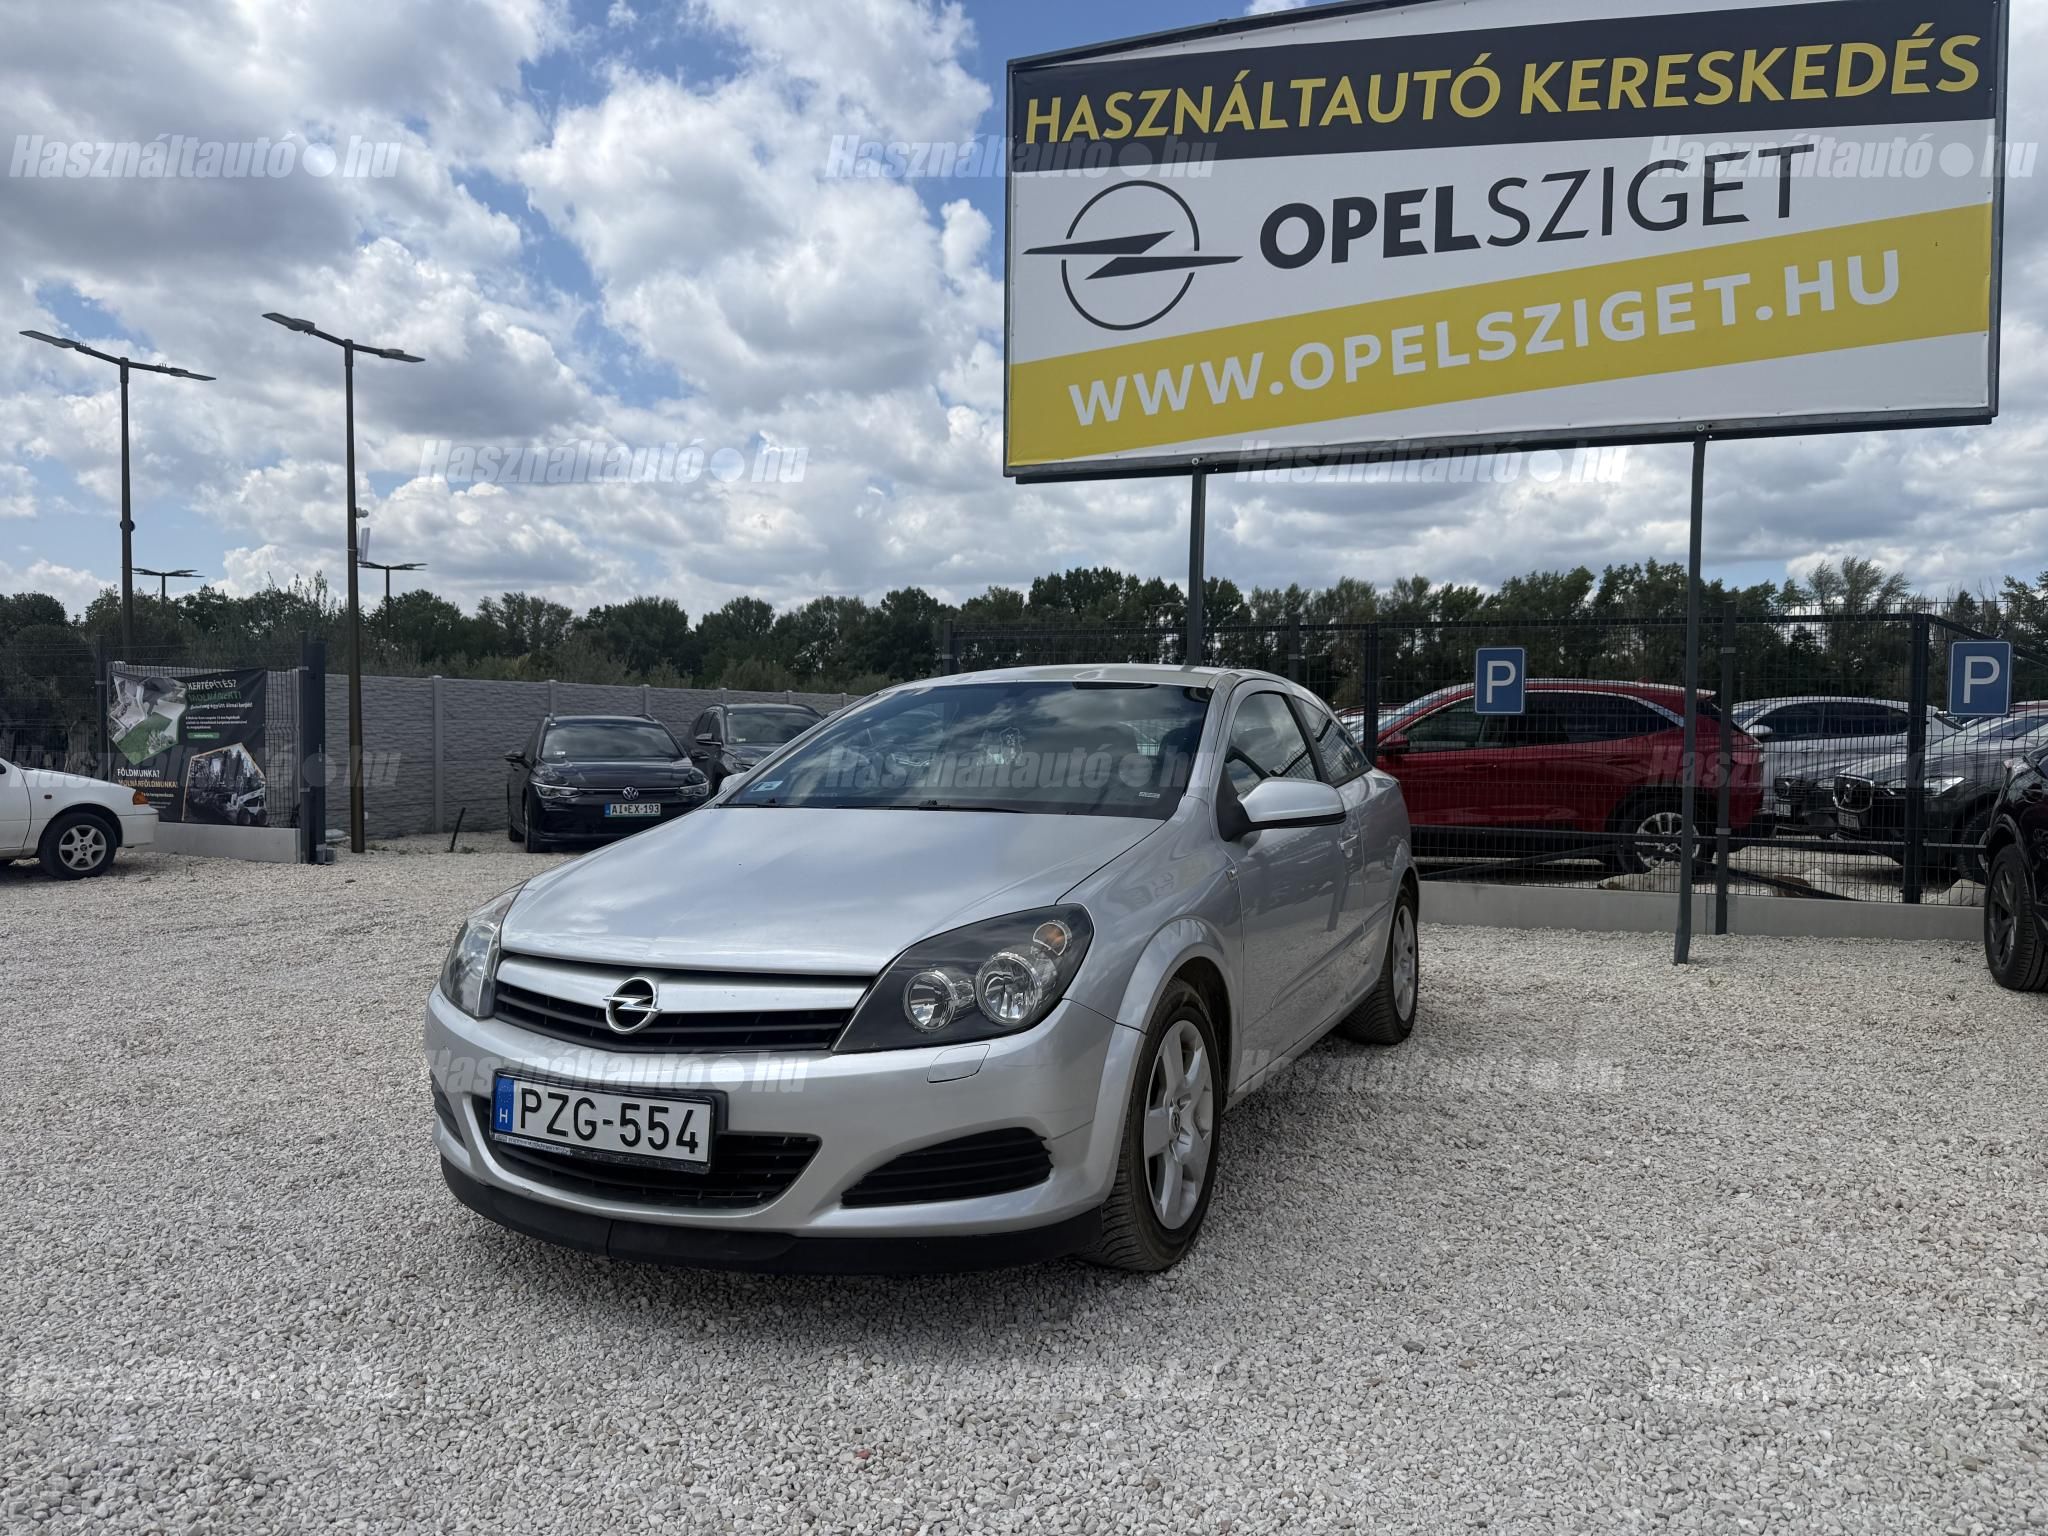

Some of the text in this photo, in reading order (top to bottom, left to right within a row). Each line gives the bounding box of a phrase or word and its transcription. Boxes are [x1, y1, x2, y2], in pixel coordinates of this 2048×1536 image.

[1023, 23, 1980, 144] HASZNÁLTAUTÓ KERESKEDÉS
[1259, 144, 1814, 269] OPELSZIGET
[1069, 249, 1901, 427] WWW.OPELSZIGET.HU
[1487, 661, 1516, 703] P
[1964, 656, 2000, 703] P
[499, 1107, 509, 1124] H
[519, 1087, 699, 1154] PZG-554
